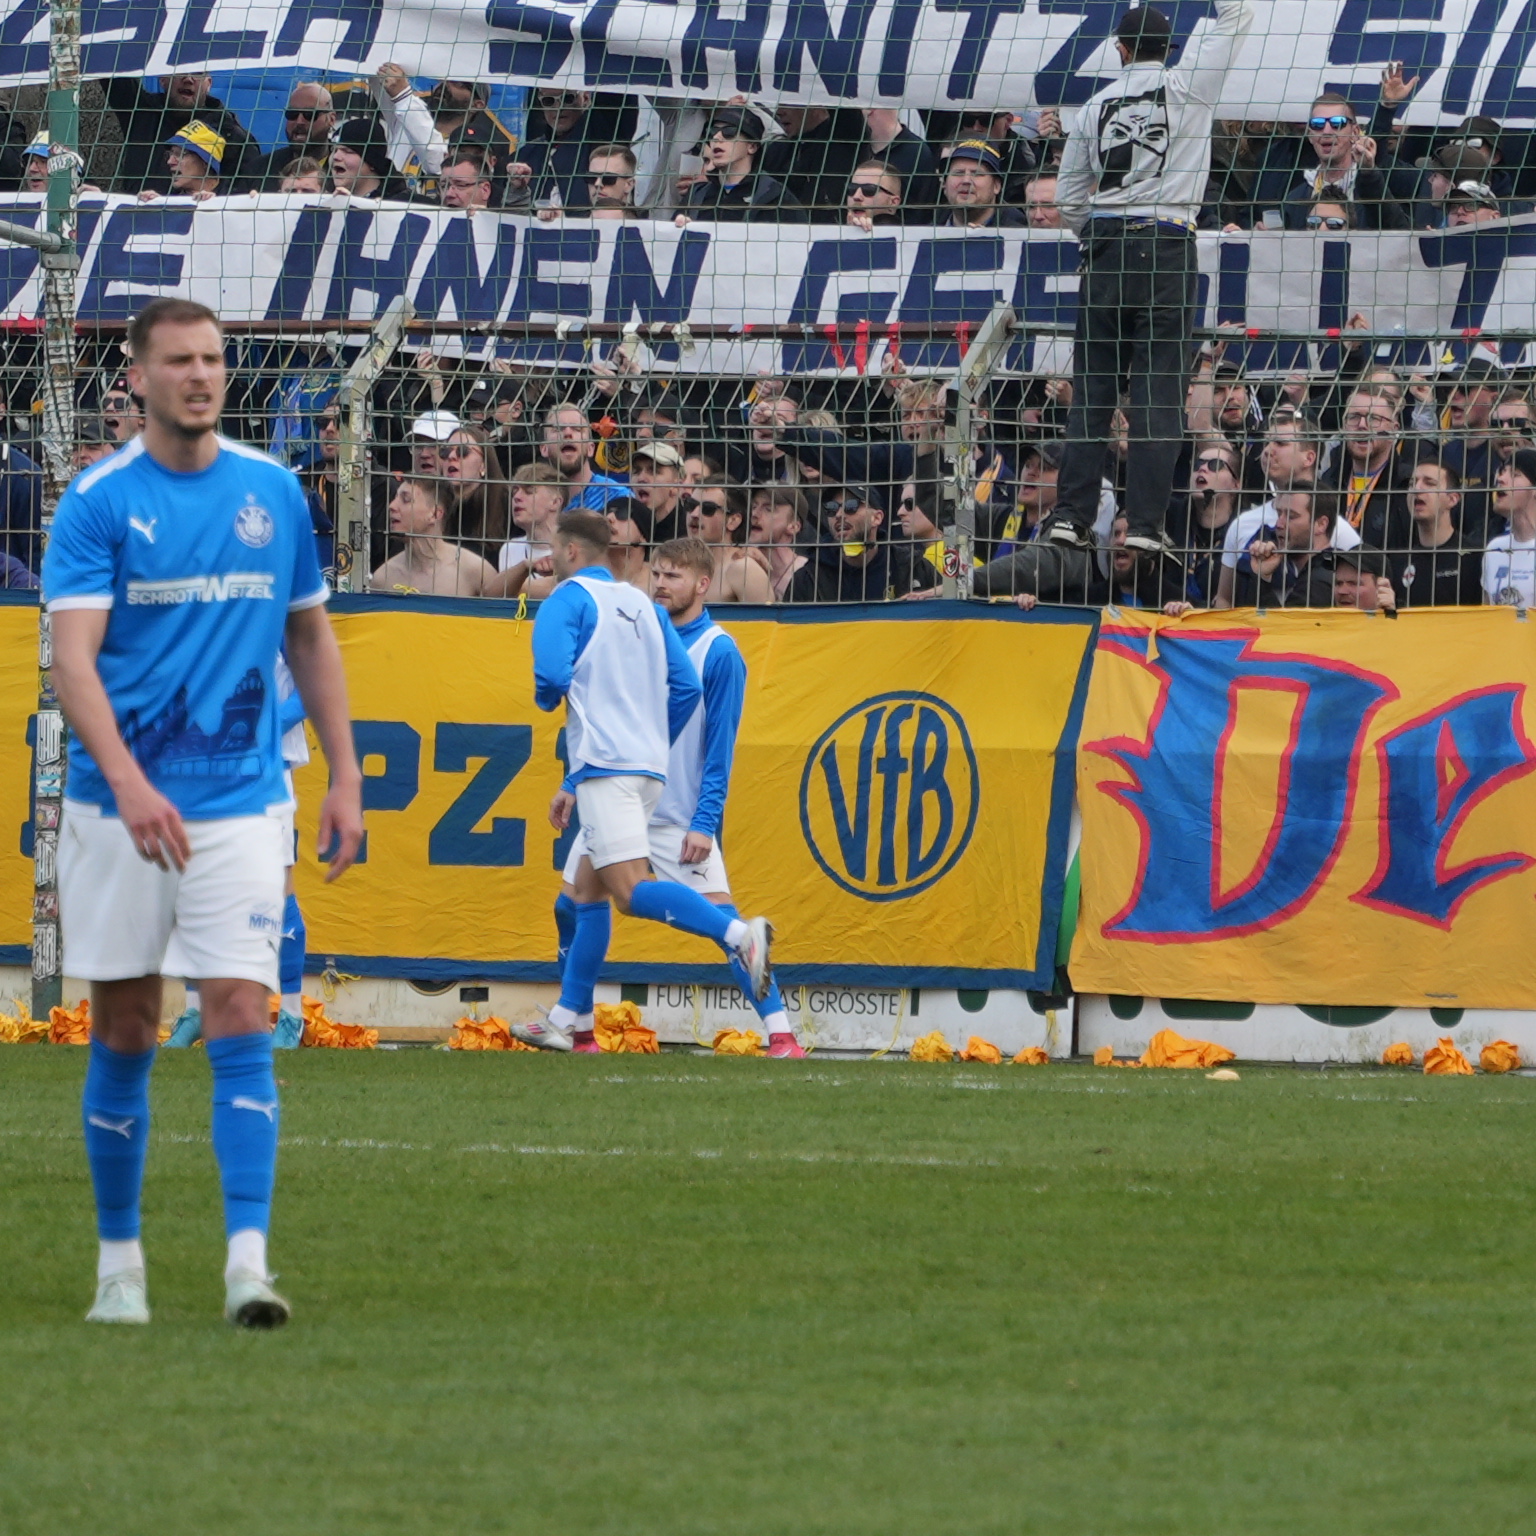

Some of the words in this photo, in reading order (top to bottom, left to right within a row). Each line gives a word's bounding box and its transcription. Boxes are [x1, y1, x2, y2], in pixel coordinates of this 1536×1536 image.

[263, 205, 711, 361] IHNEN
[820, 703, 953, 887] VfB
[703, 986, 751, 1010] TIERE
[809, 987, 899, 1016] GRÖSSTE
